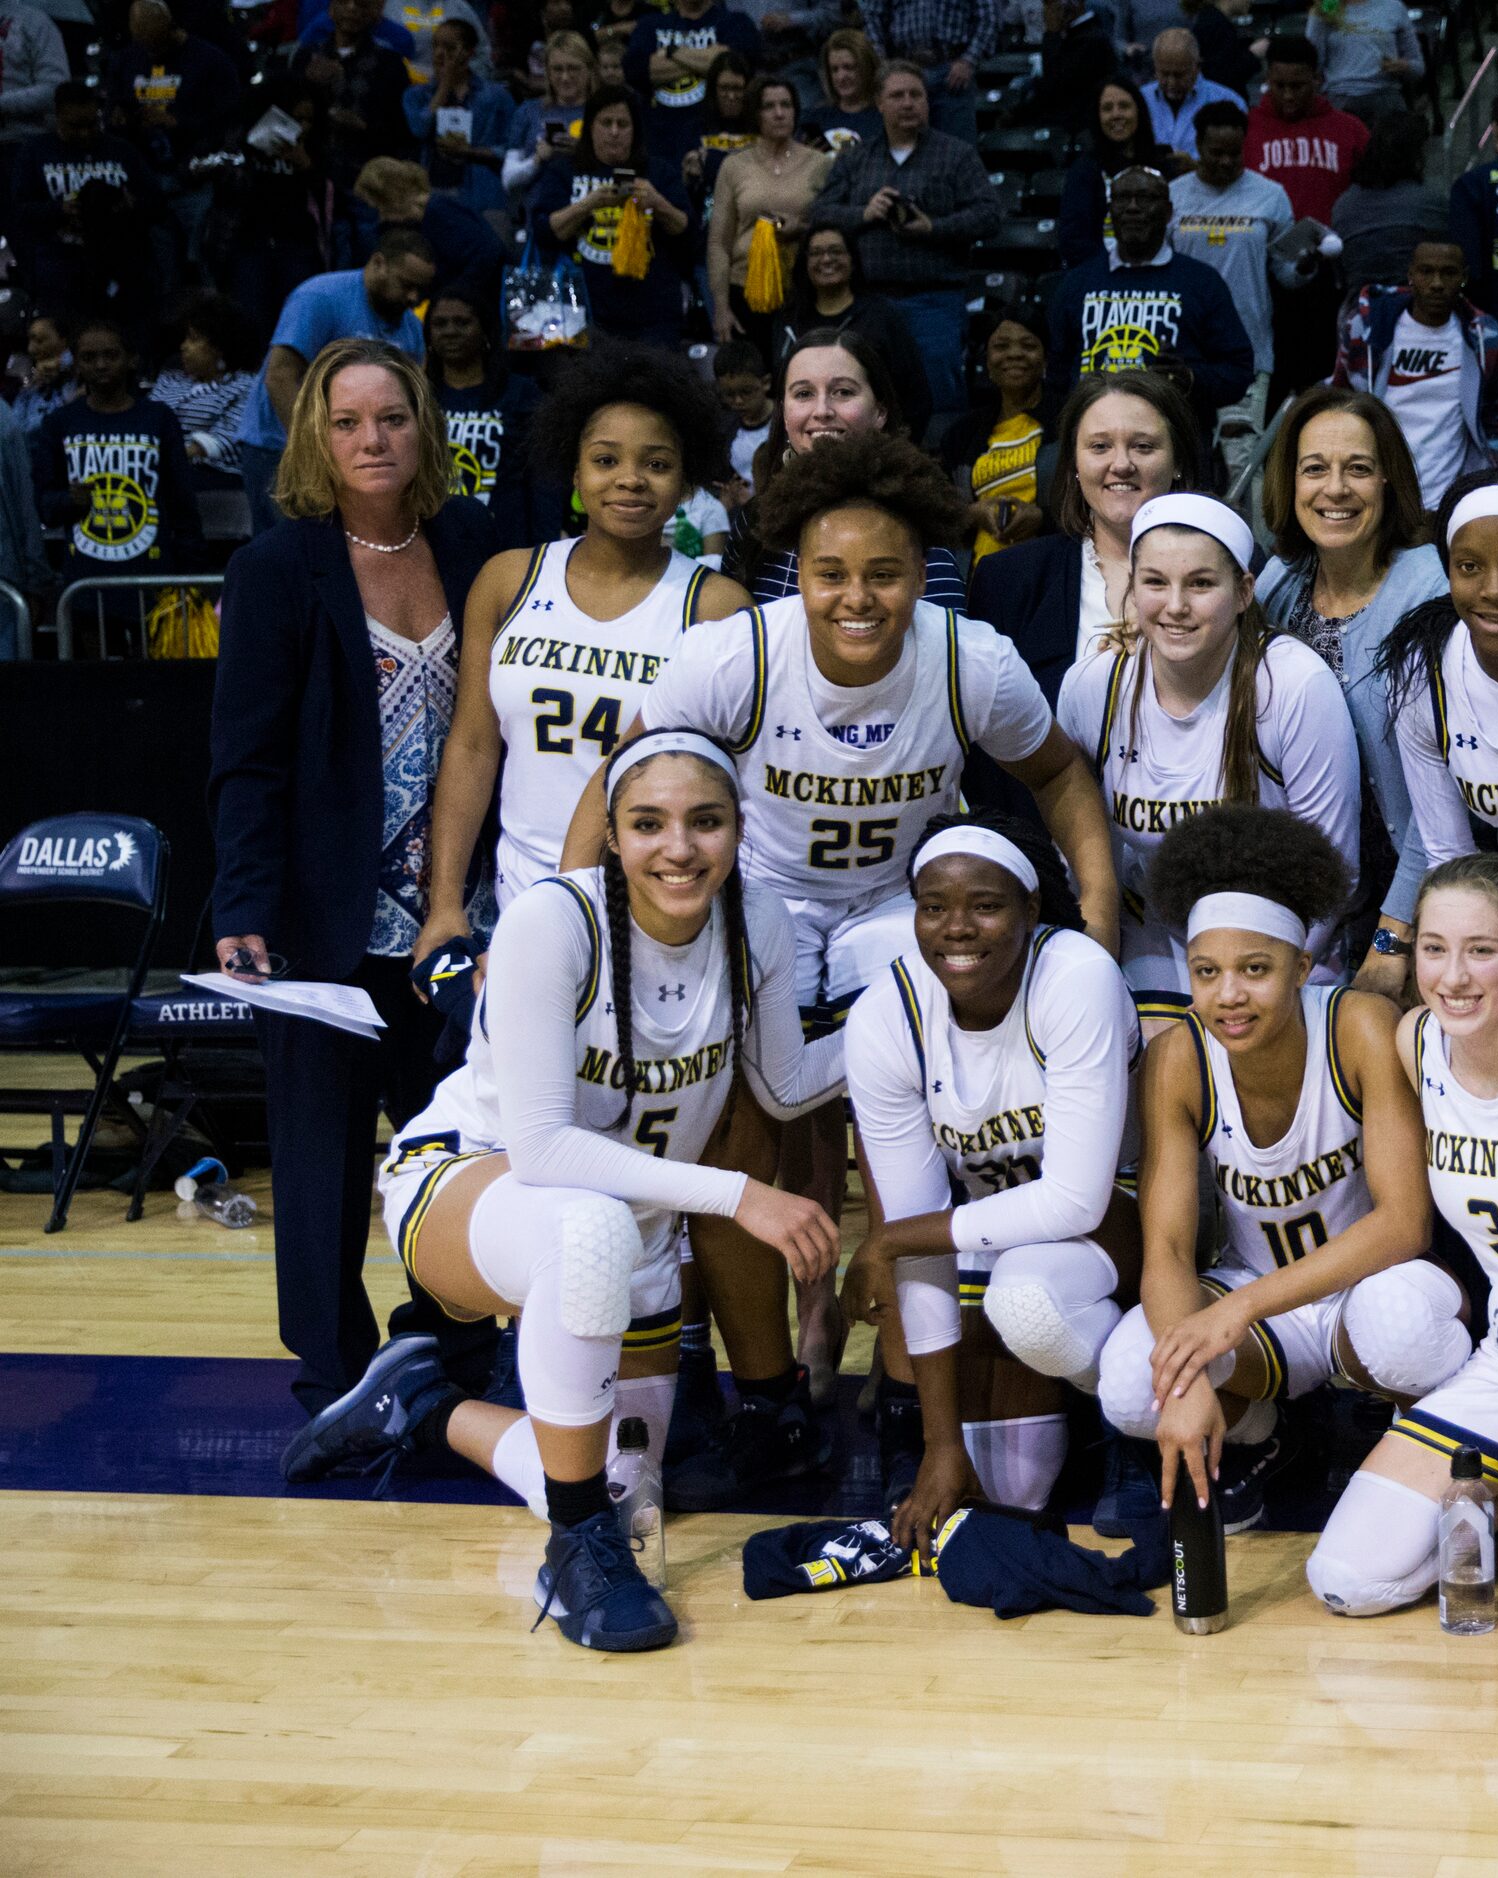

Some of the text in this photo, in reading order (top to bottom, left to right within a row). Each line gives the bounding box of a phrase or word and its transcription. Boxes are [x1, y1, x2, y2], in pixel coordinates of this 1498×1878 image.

[1259, 136, 1338, 173] JORDAN
[1180, 216, 1252, 226] MCKINNEY
[1084, 290, 1182, 301] MCKINNEY
[1081, 299, 1183, 350] PLAYOFFS
[1395, 348, 1448, 373] NIKE
[446, 409, 503, 420] INNEY
[447, 419, 504, 470] OFFS
[63, 443, 160, 500] PLAYOFFS
[499, 636, 668, 685] MCKINNE
[530, 687, 622, 757] 24
[825, 725, 858, 744] NG
[764, 763, 947, 807] MCKINNEY
[1113, 789, 1219, 833] MCKIN
[19, 837, 112, 867] DALLAS
[808, 817, 899, 870] 25
[16, 866, 105, 877] INDEPENDENT SCHOOL DISTRICT
[159, 1001, 254, 1021] ATHLET
[634, 1104, 679, 1159] 5
[931, 1103, 1045, 1157] CKINNE
[1259, 1211, 1328, 1269] 10
